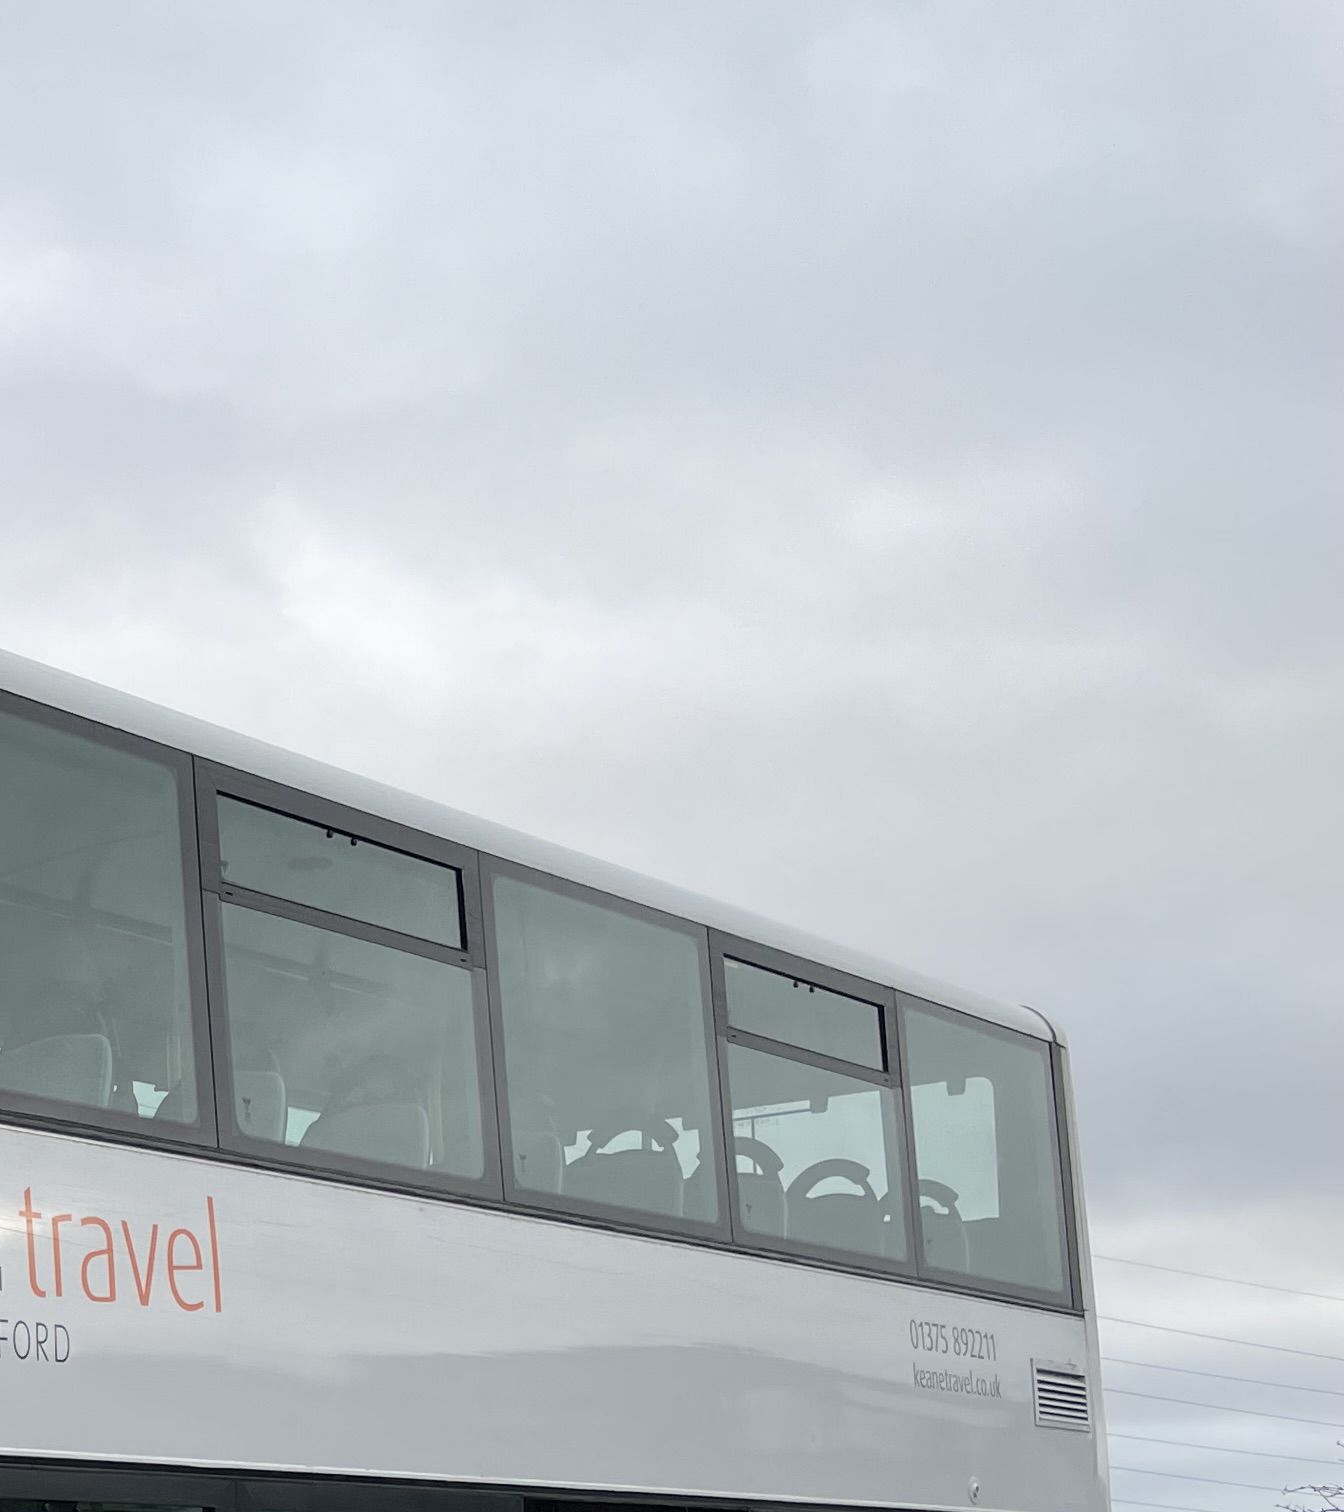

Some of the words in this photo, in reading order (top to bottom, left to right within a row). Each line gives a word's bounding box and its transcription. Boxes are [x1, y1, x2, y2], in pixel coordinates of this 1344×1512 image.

[18, 1186, 222, 1313] travel
[909, 1318, 949, 1354] 01375
[951, 1325, 996, 1361] 892211
[912, 1361, 1002, 1399] keanetravel.co.uk
